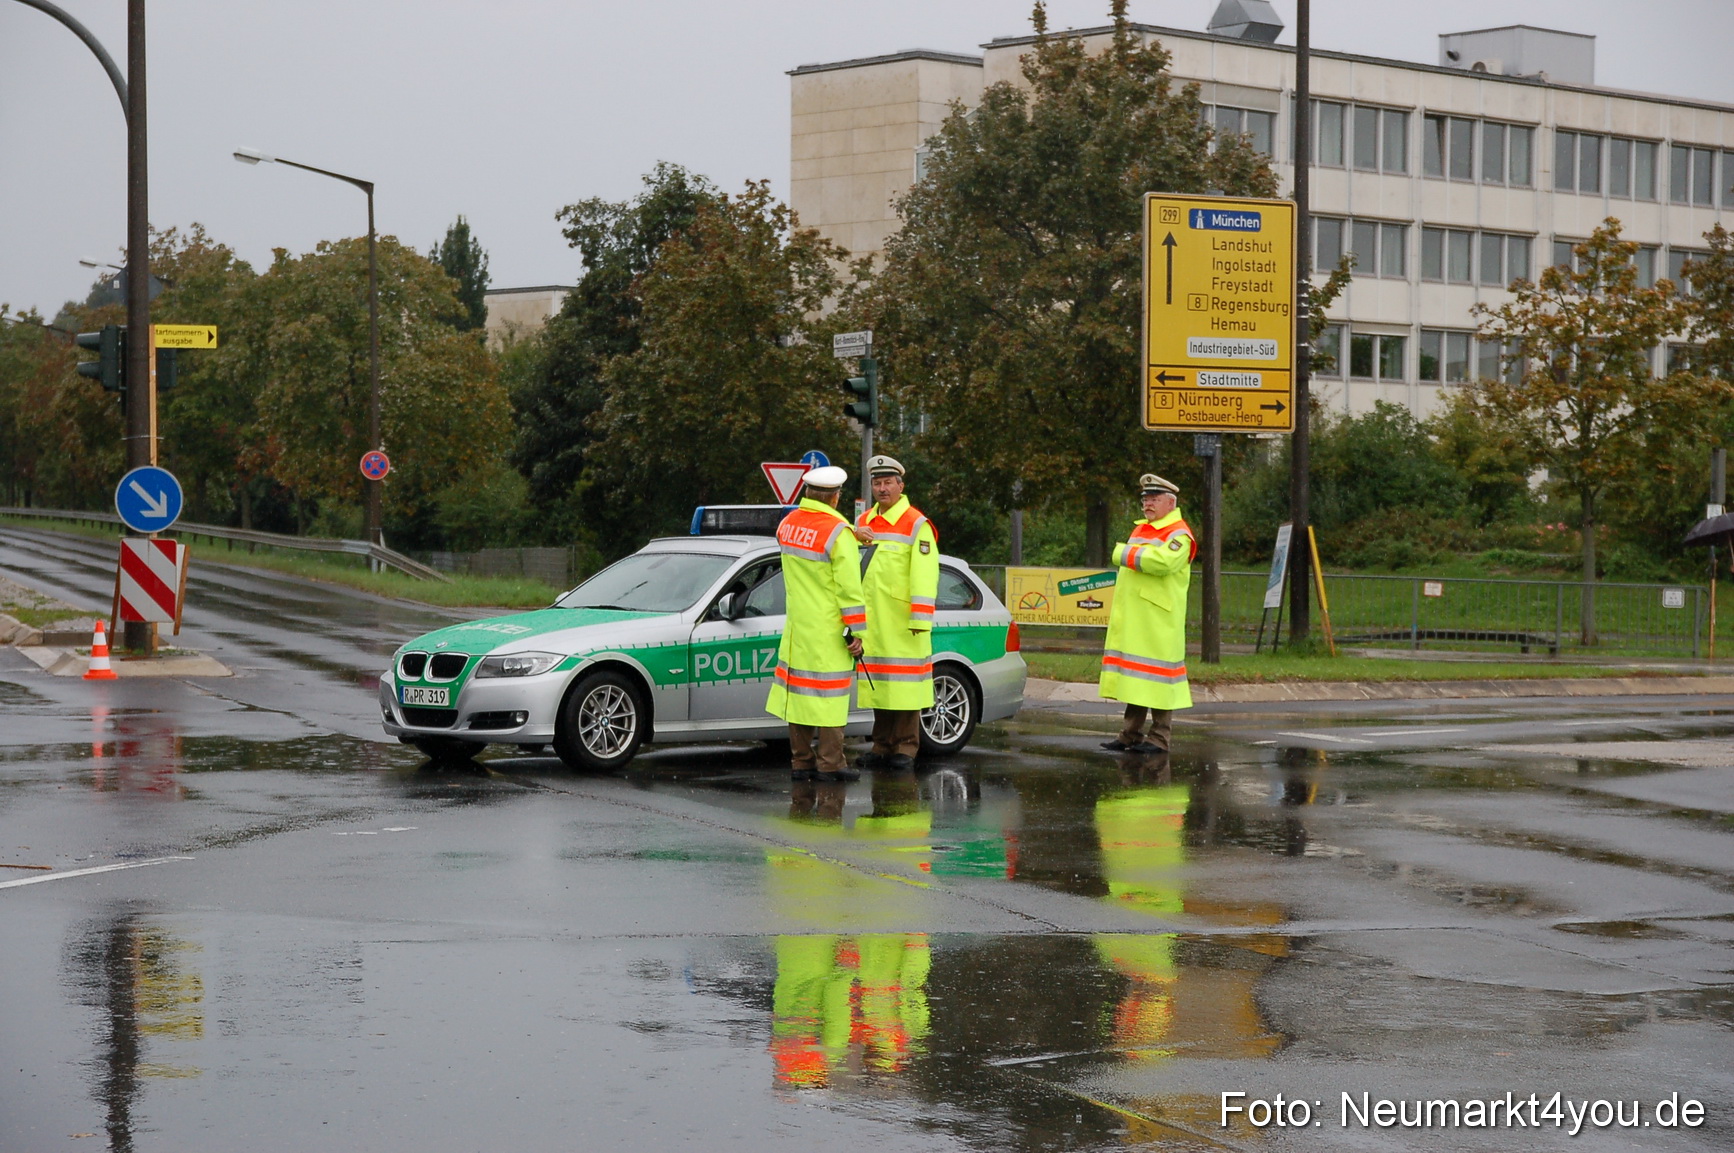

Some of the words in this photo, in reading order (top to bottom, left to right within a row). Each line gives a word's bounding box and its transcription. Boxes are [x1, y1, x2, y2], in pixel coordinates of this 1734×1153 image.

[1162, 209, 1178, 222] 299
[1212, 213, 1260, 229] München
[1212, 237, 1273, 254] Landshut
[1212, 257, 1277, 275] Ingolstadt
[1211, 277, 1274, 294] Freystadt
[1194, 297, 1202, 309] 8
[1211, 297, 1289, 316] Regensburg
[1211, 317, 1257, 332] Hemau
[162, 338, 193, 346] ausgabe
[1189, 341, 1276, 358] Industriegebiet-Süd
[1199, 373, 1260, 387] Stadtmitte
[1160, 395, 1168, 407] 8
[1178, 391, 1243, 411] Nürnberg
[1178, 410, 1264, 426] Postbauer-Heng
[780, 523, 819, 548] POLIZEI
[1038, 614, 1075, 624] MICHAELIS
[1076, 615, 1110, 625] KIRCHWE
[694, 647, 777, 678] POLIZ
[428, 690, 446, 704] 319
